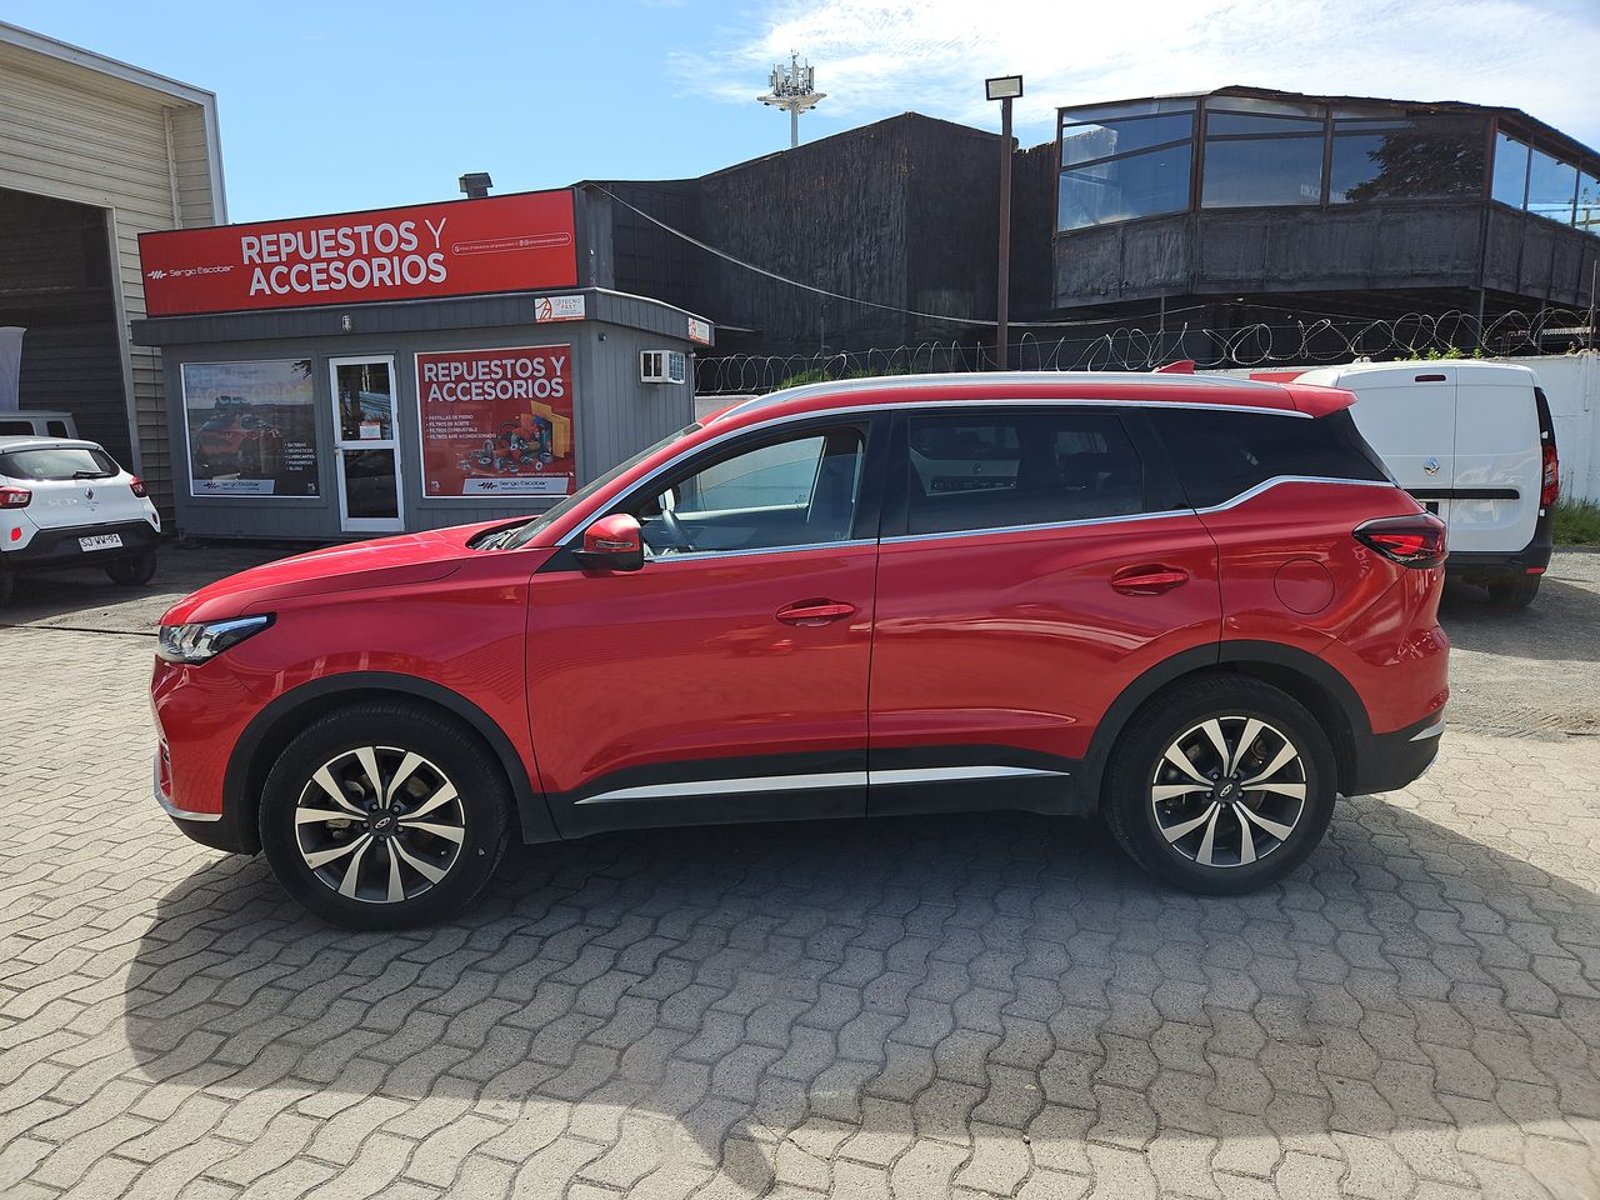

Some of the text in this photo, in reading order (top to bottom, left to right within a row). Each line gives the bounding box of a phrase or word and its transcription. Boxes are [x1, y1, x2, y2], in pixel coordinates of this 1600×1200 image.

[241, 217, 447, 264] REPUESTOS Y
[197, 265, 235, 275] Escobar
[249, 252, 447, 296] ACCESORIOS
[424, 356, 565, 382] REPUESTOS Y
[428, 378, 565, 402] ACCESORIOS
